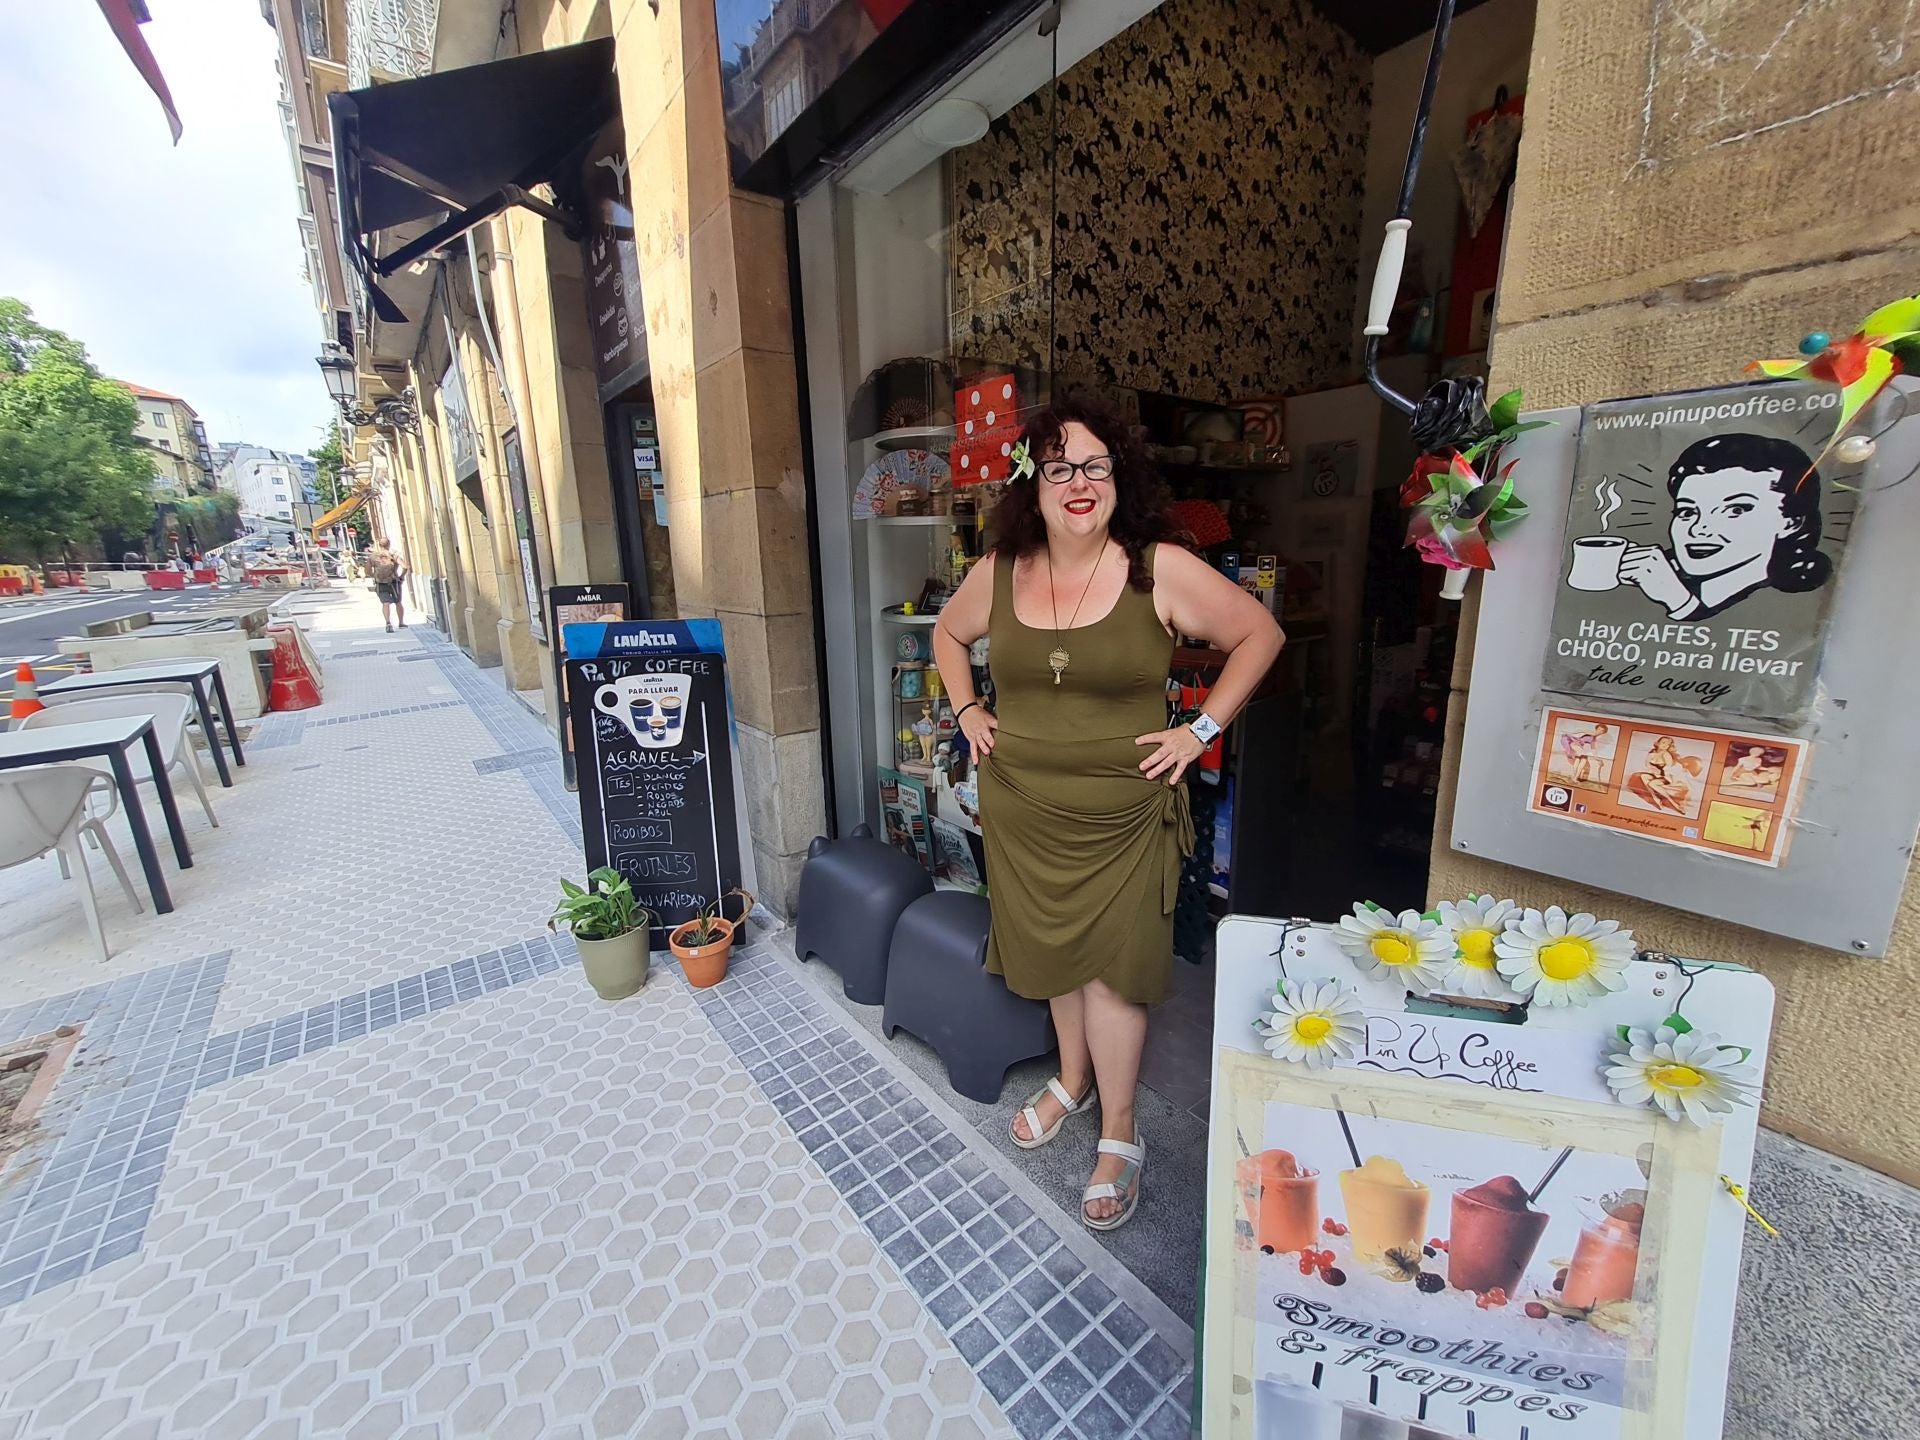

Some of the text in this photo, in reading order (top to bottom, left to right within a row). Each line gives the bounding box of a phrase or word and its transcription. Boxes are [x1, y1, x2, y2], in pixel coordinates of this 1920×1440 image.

[1595, 392, 1843, 430] www.pinupcoffee.co
[576, 594, 602, 602] AMBAR
[613, 630, 677, 648] LAVAZZA
[1578, 619, 1780, 651] Hay CAFES, TES
[645, 658, 710, 675] COFFEE
[1556, 638, 1803, 677] CHOCO, para llevar
[1587, 665, 1732, 704] take away
[605, 750, 680, 765] AGRANEL
[1365, 1016, 1539, 1090] Pin Up Coffee
[1272, 1292, 1605, 1390] Smoothies
[1276, 1328, 1327, 1354] &
